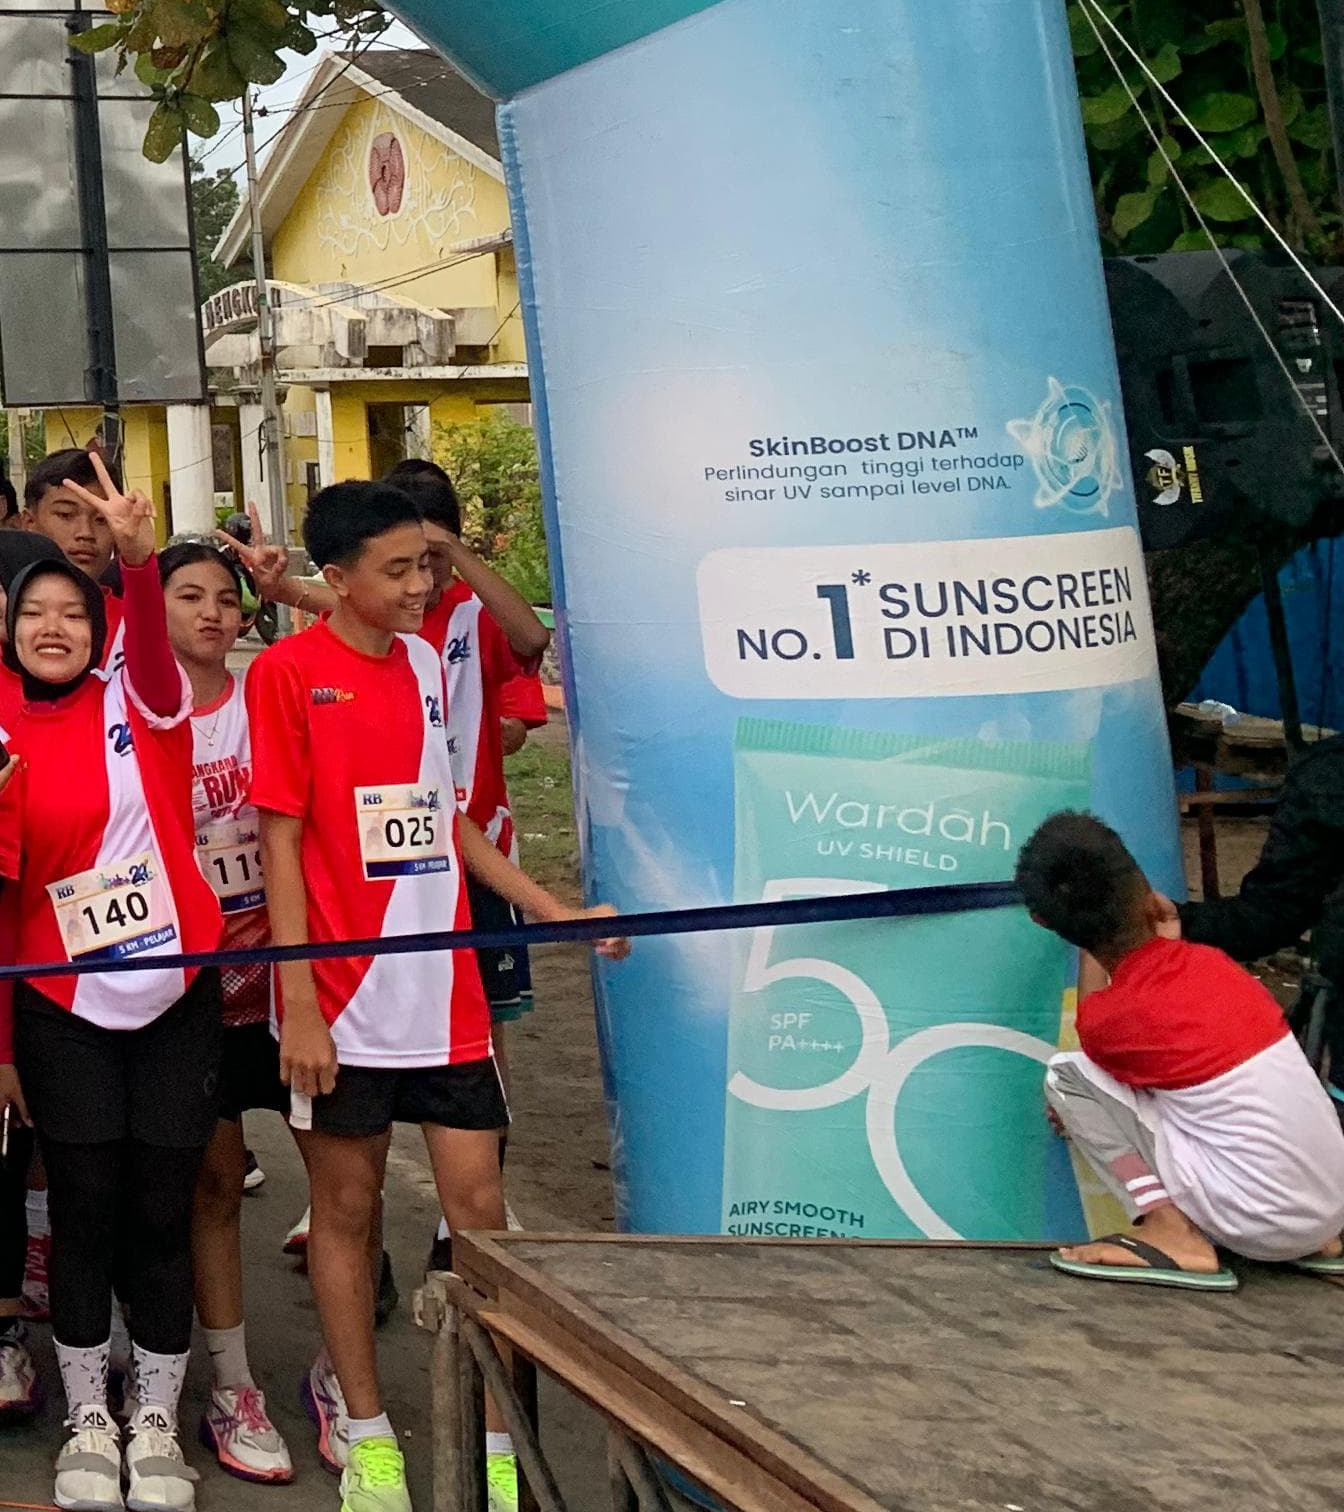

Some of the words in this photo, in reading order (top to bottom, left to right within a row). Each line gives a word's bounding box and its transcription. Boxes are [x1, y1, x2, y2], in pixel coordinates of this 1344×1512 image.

[749, 433, 891, 457] SkinBoost
[705, 461, 848, 485] Perlindungan
[861, 457, 925, 477] tinggi
[931, 451, 1025, 474] terhadap
[725, 486, 775, 503] sinar
[783, 485, 812, 501] UV
[820, 481, 905, 503] sampai
[912, 477, 961, 495] level
[967, 476, 1011, 493] DNA.
[878, 566, 1133, 620] SUNSCREEN
[884, 626, 930, 660] DI
[946, 610, 1137, 657] INDONESIA
[203, 767, 251, 809] RUN
[363, 793, 382, 805] RB
[385, 816, 435, 848] 025
[817, 840, 849, 857] UV
[860, 842, 958, 872] SHIELD
[56, 885, 75, 900] RB
[82, 891, 149, 935] 140
[118, 944, 125, 954] 5
[126, 941, 139, 953] KM
[143, 929, 174, 947] PELAJAR
[768, 1012, 812, 1029] SPF
[729, 1200, 771, 1218] AIRY
[773, 1200, 865, 1229] SMOOTH
